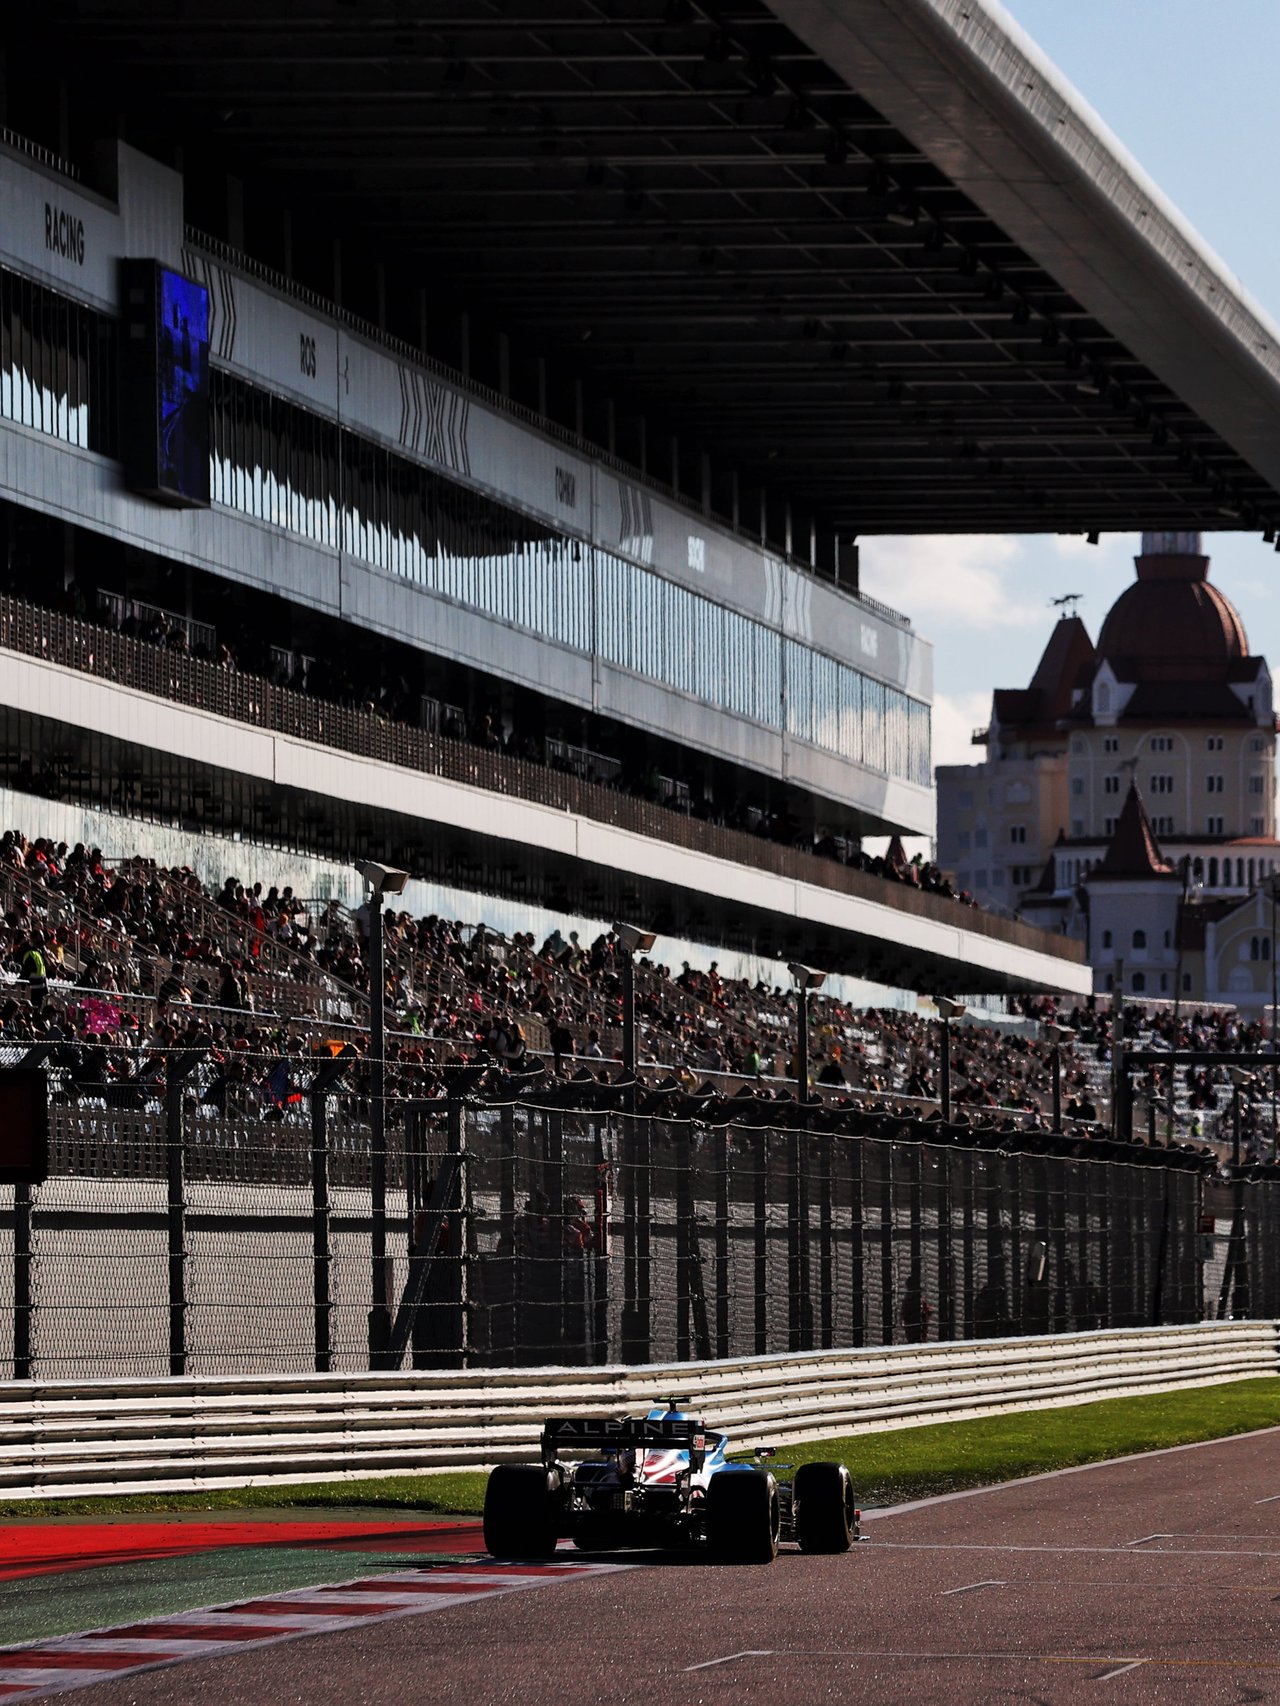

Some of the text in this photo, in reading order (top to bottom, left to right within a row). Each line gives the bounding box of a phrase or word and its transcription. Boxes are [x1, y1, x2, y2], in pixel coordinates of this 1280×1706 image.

[45, 202, 84, 266] RACING
[300, 333, 316, 379] ROS
[557, 1421, 689, 1435] ALPINE
